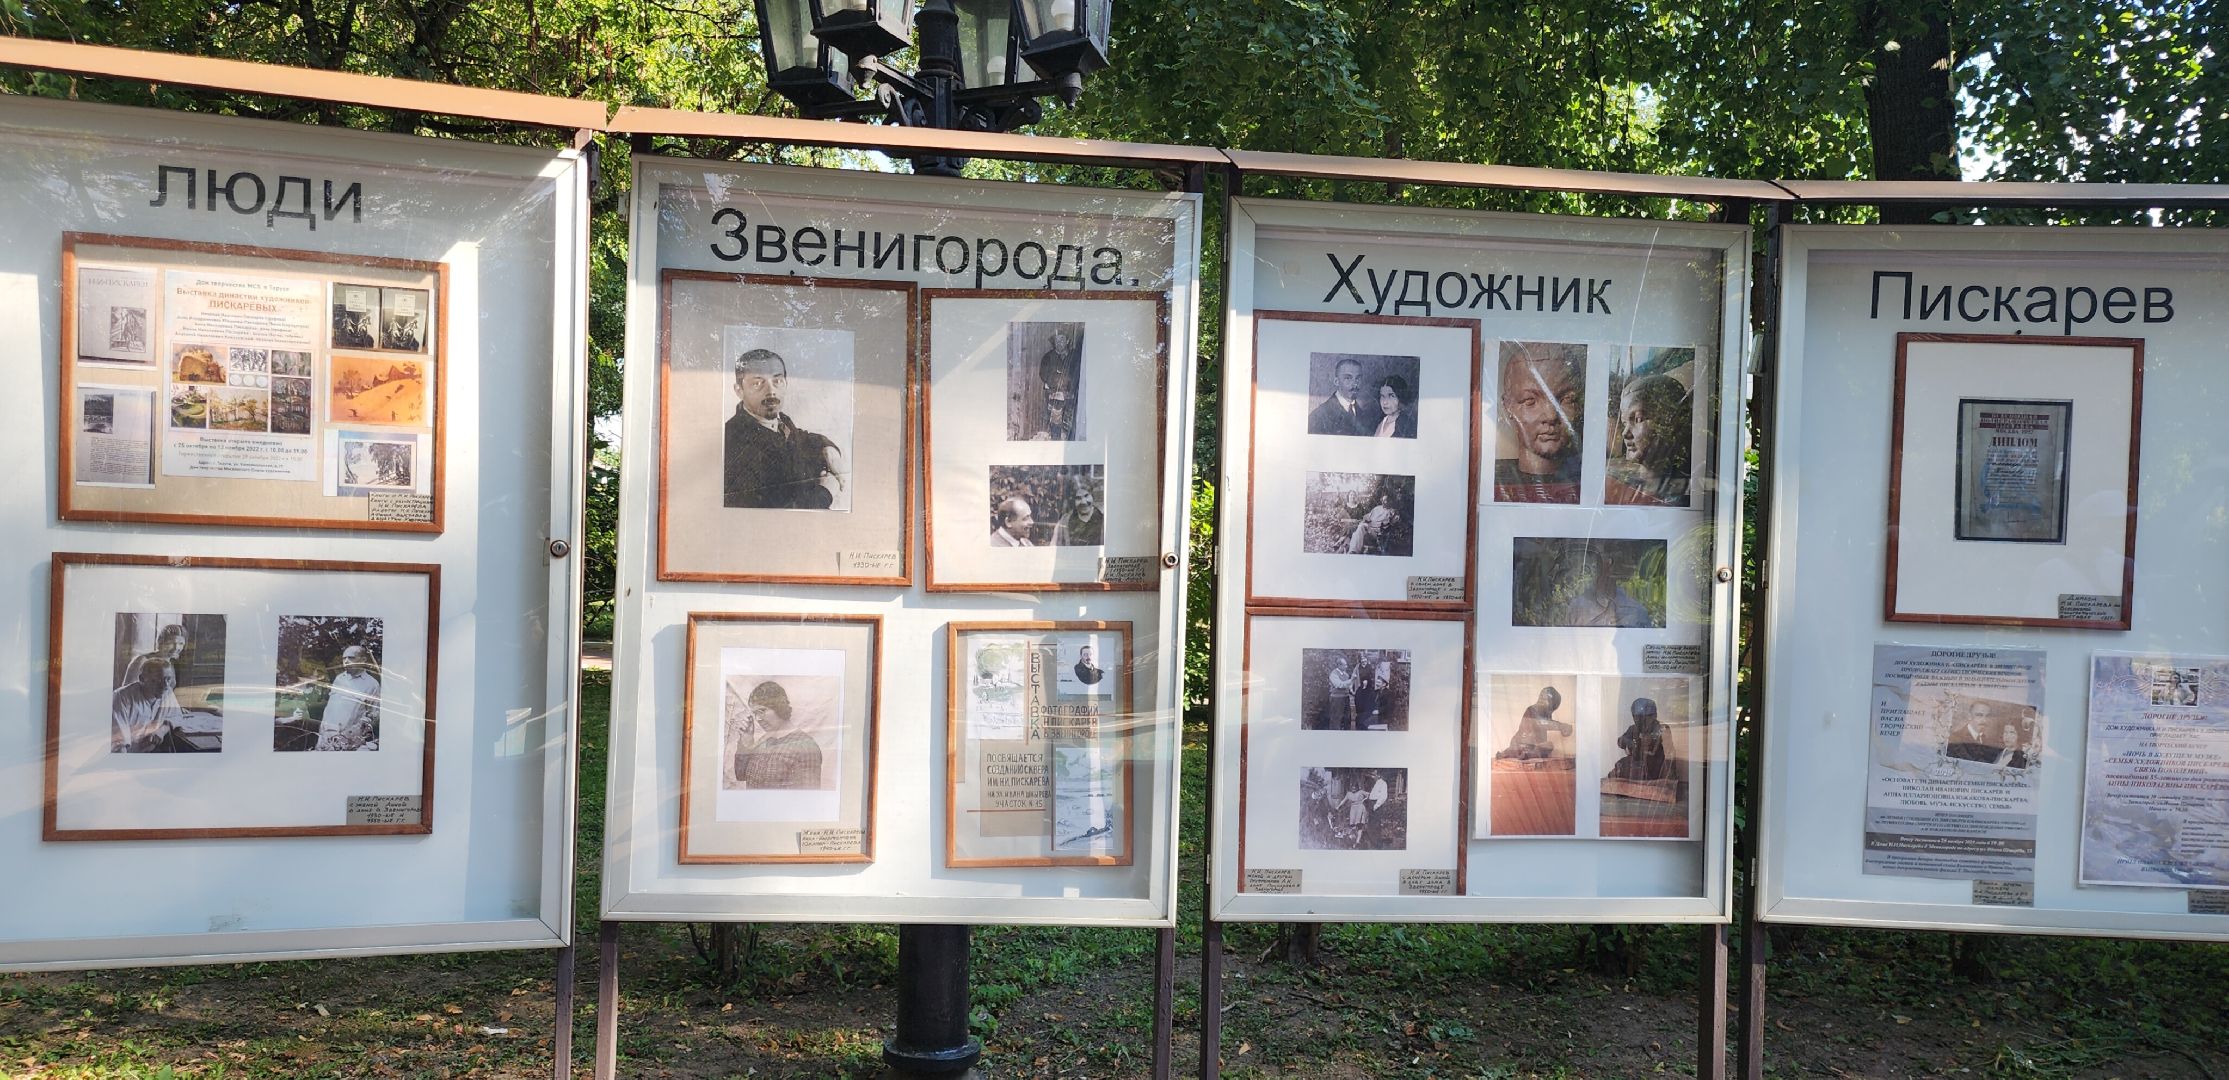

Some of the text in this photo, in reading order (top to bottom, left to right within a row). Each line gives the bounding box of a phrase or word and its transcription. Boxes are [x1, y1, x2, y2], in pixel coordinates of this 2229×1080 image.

[208, 300, 278, 313] ПИСКАРЕВЫХ
[1322, 253, 1612, 316] Художник
[1870, 270, 2175, 335] Пискарев
